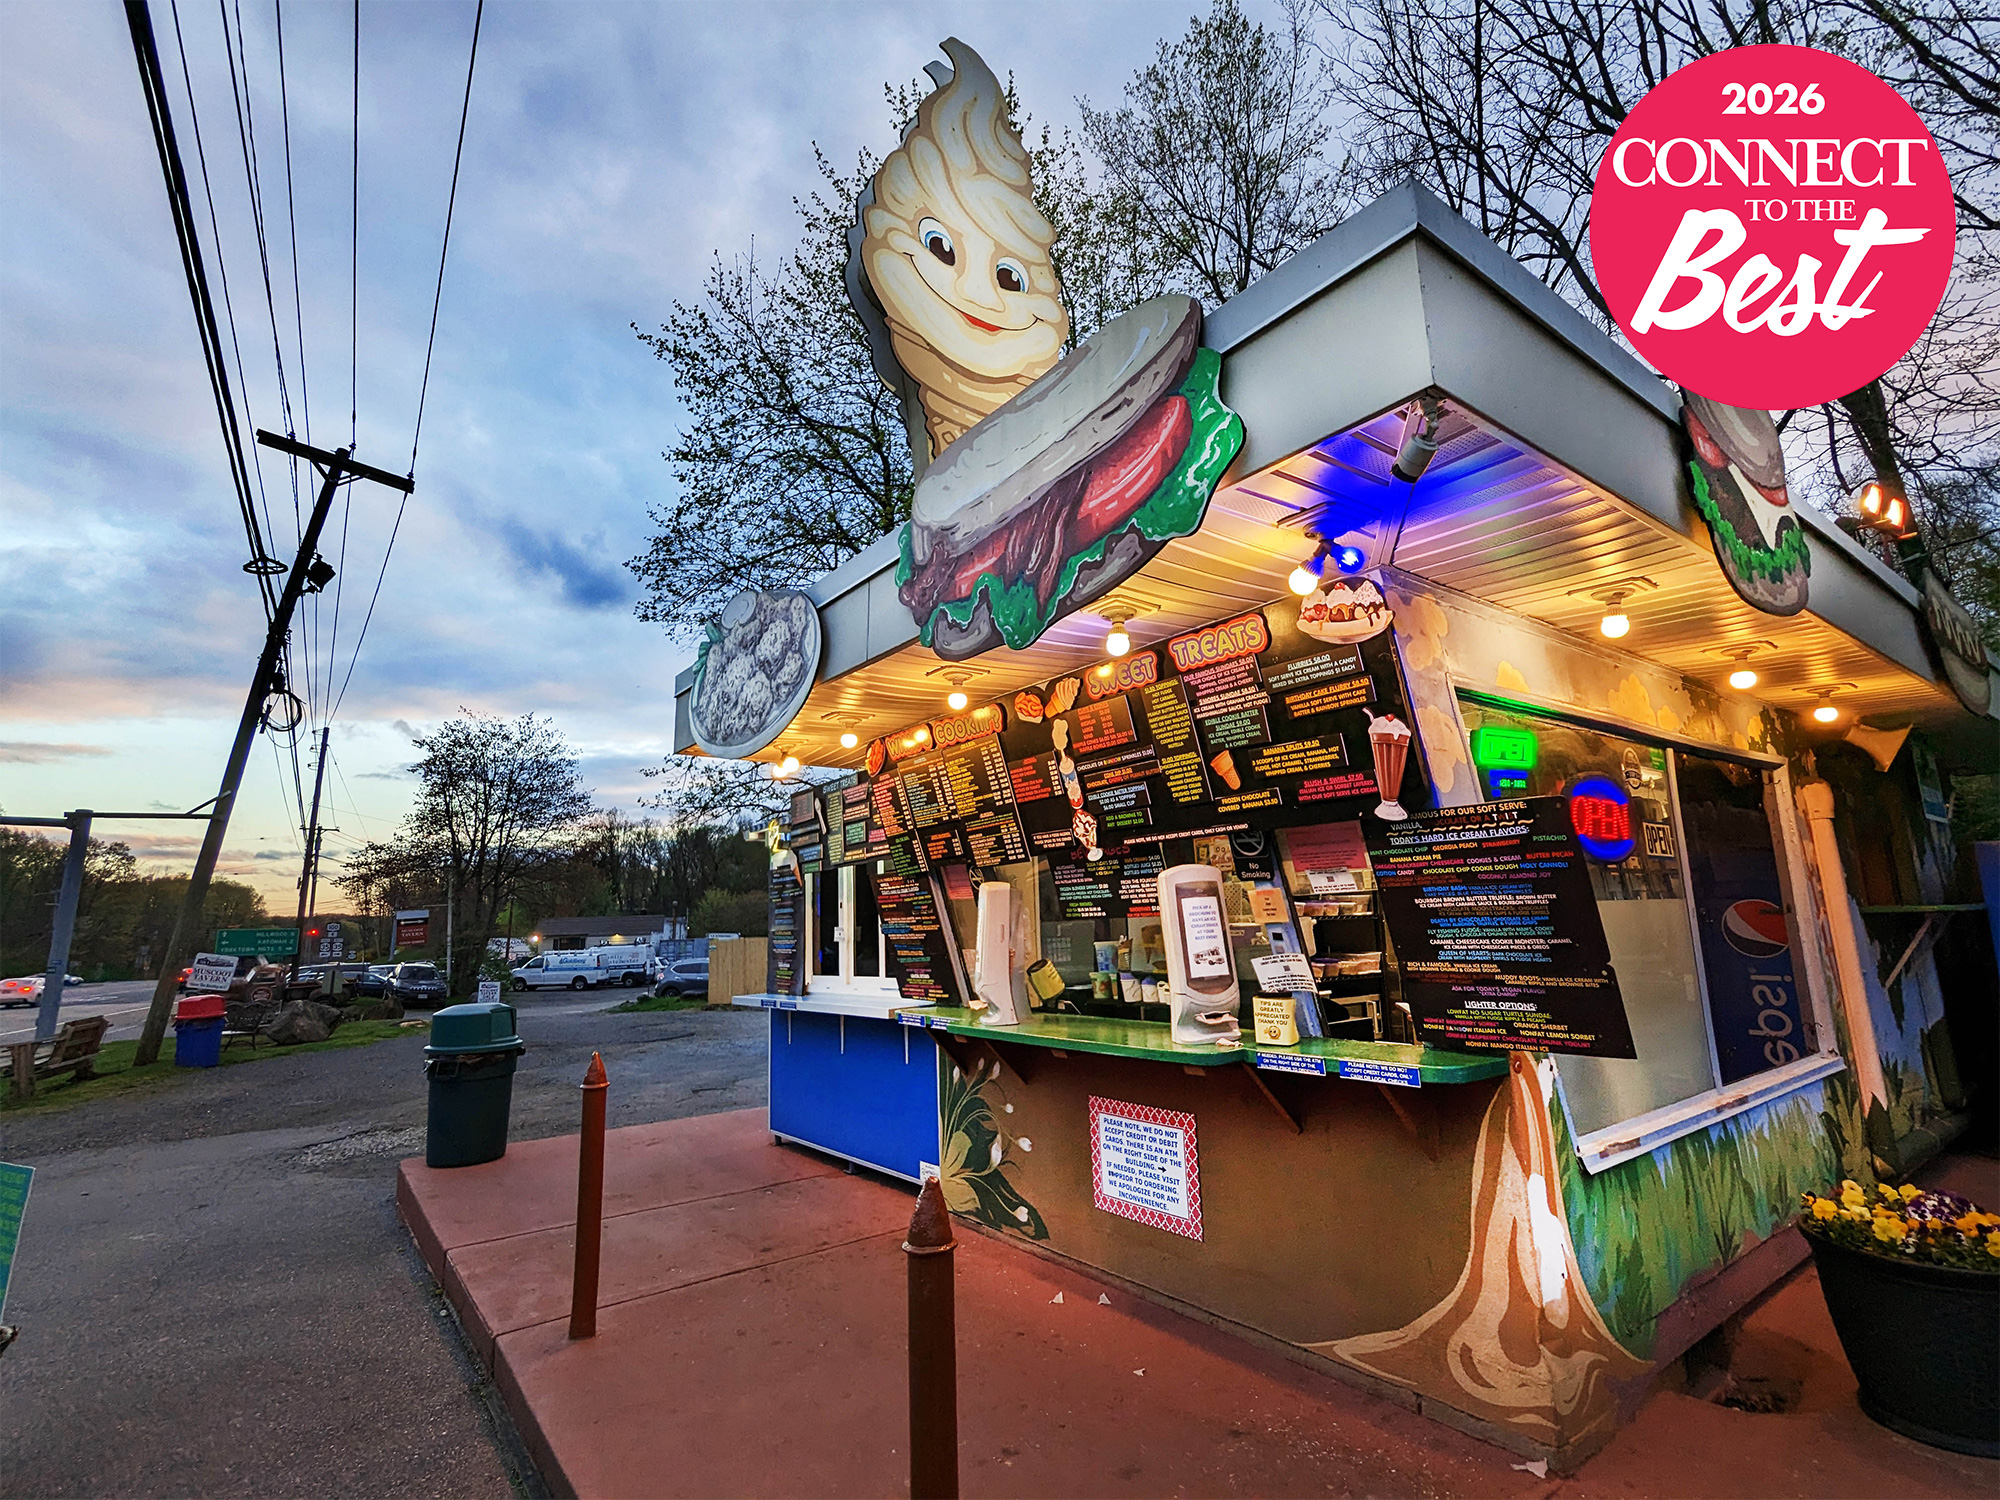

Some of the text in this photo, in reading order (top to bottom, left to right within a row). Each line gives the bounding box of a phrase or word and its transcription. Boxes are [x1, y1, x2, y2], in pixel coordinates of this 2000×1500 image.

[1088, 620, 1262, 693] SWEET TREATS
[1287, 659, 1312, 671] FLURRIES
[1304, 666, 1320, 674] CREAM
[1339, 656, 1357, 664] CANDY
[1310, 670, 1334, 679] TOPPINGS
[1285, 692, 1312, 704] BIRTHDAY
[1313, 687, 1328, 697] CAKE
[1329, 683, 1351, 693] FLURRY
[1290, 702, 1310, 710] VANILLA
[1316, 703, 1339, 712] RAINBOW
[1340, 696, 1366, 706] SPRINKLES
[1263, 746, 1286, 756] BANANA
[1287, 742, 1303, 752] SPLITS
[823, 782, 839, 793] SWEET
[841, 776, 856, 786] TREATS
[1242, 792, 1270, 801] CHOCOLATE
[1218, 804, 1240, 813] COVERED
[1242, 801, 1263, 809] BANANA
[1410, 810, 1439, 819] AMOUS
[1458, 807, 1475, 815] OUR
[1477, 805, 1496, 814] SOFT
[1499, 802, 1527, 811] SERVE:
[1570, 795, 1629, 840] OPEN
[1390, 822, 1423, 831] VANILLA,
[1390, 826, 1530, 845] TODAY'S HARD ICE CREAM FLAVORS:
[1646, 825, 1672, 854] OPEN
[1241, 871, 1271, 879] Smoking
[195, 968, 232, 977] MUSCOOT
[1464, 1001, 1538, 1011] LIGHTER OPTIONS:
[1547, 1031, 1569, 1039] LEMON
[1104, 1117, 1123, 1127] PLEASE
[1124, 1122, 1141, 1132] NOTE,
[1105, 1126, 1124, 1136] ACCEPT
[1126, 1131, 1146, 1141] CREDIT
[1159, 1139, 1178, 1148] DEBIT
[1105, 1135, 1124, 1145] CARDS.
[1126, 1140, 1144, 1150] THERE
[1112, 1145, 1122, 1153] THE
[1124, 1148, 1142, 1158] RIGHT
[1144, 1153, 1158, 1162] SIDE
[1170, 1159, 1182, 1168] THE
[1126, 1158, 1156, 1170] BUILDING.
[1113, 1163, 1137, 1175] NEEDED,
[1139, 1170, 1160, 1180] PLEASE
[1162, 1176, 1180, 1185] VISIT
[1119, 1182, 1151, 1196] APOLOGIZE
[1153, 1192, 1165, 1200] FOR
[1167, 1196, 1180, 1204] ANY
[1144, 1180, 1179, 1195] ORDERING.
[1118, 1191, 1169, 1211] INCONVENIENCE.
